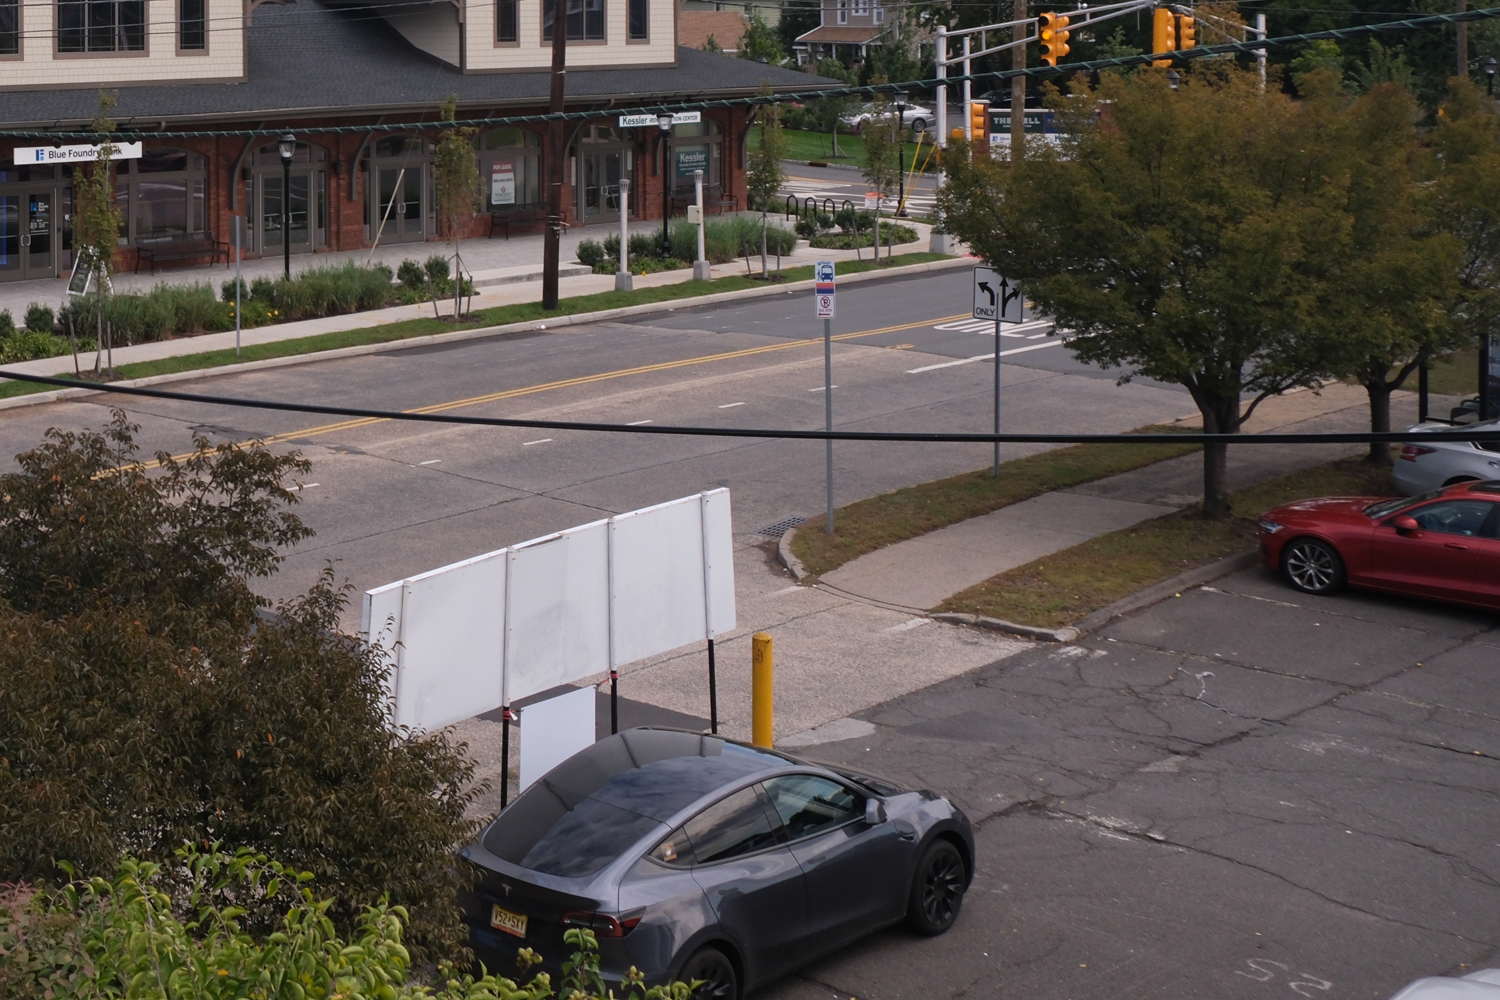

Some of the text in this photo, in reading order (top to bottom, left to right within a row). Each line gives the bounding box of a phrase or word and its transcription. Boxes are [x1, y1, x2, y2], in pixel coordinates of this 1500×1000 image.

[622, 116, 648, 126] Kessler
[682, 114, 699, 122] CENTER
[994, 117, 1011, 125] THE
[48, 149, 67, 160] Blue
[68, 148, 101, 160] Foundry
[680, 152, 706, 163] Kessler
[975, 307, 996, 317] ONLY
